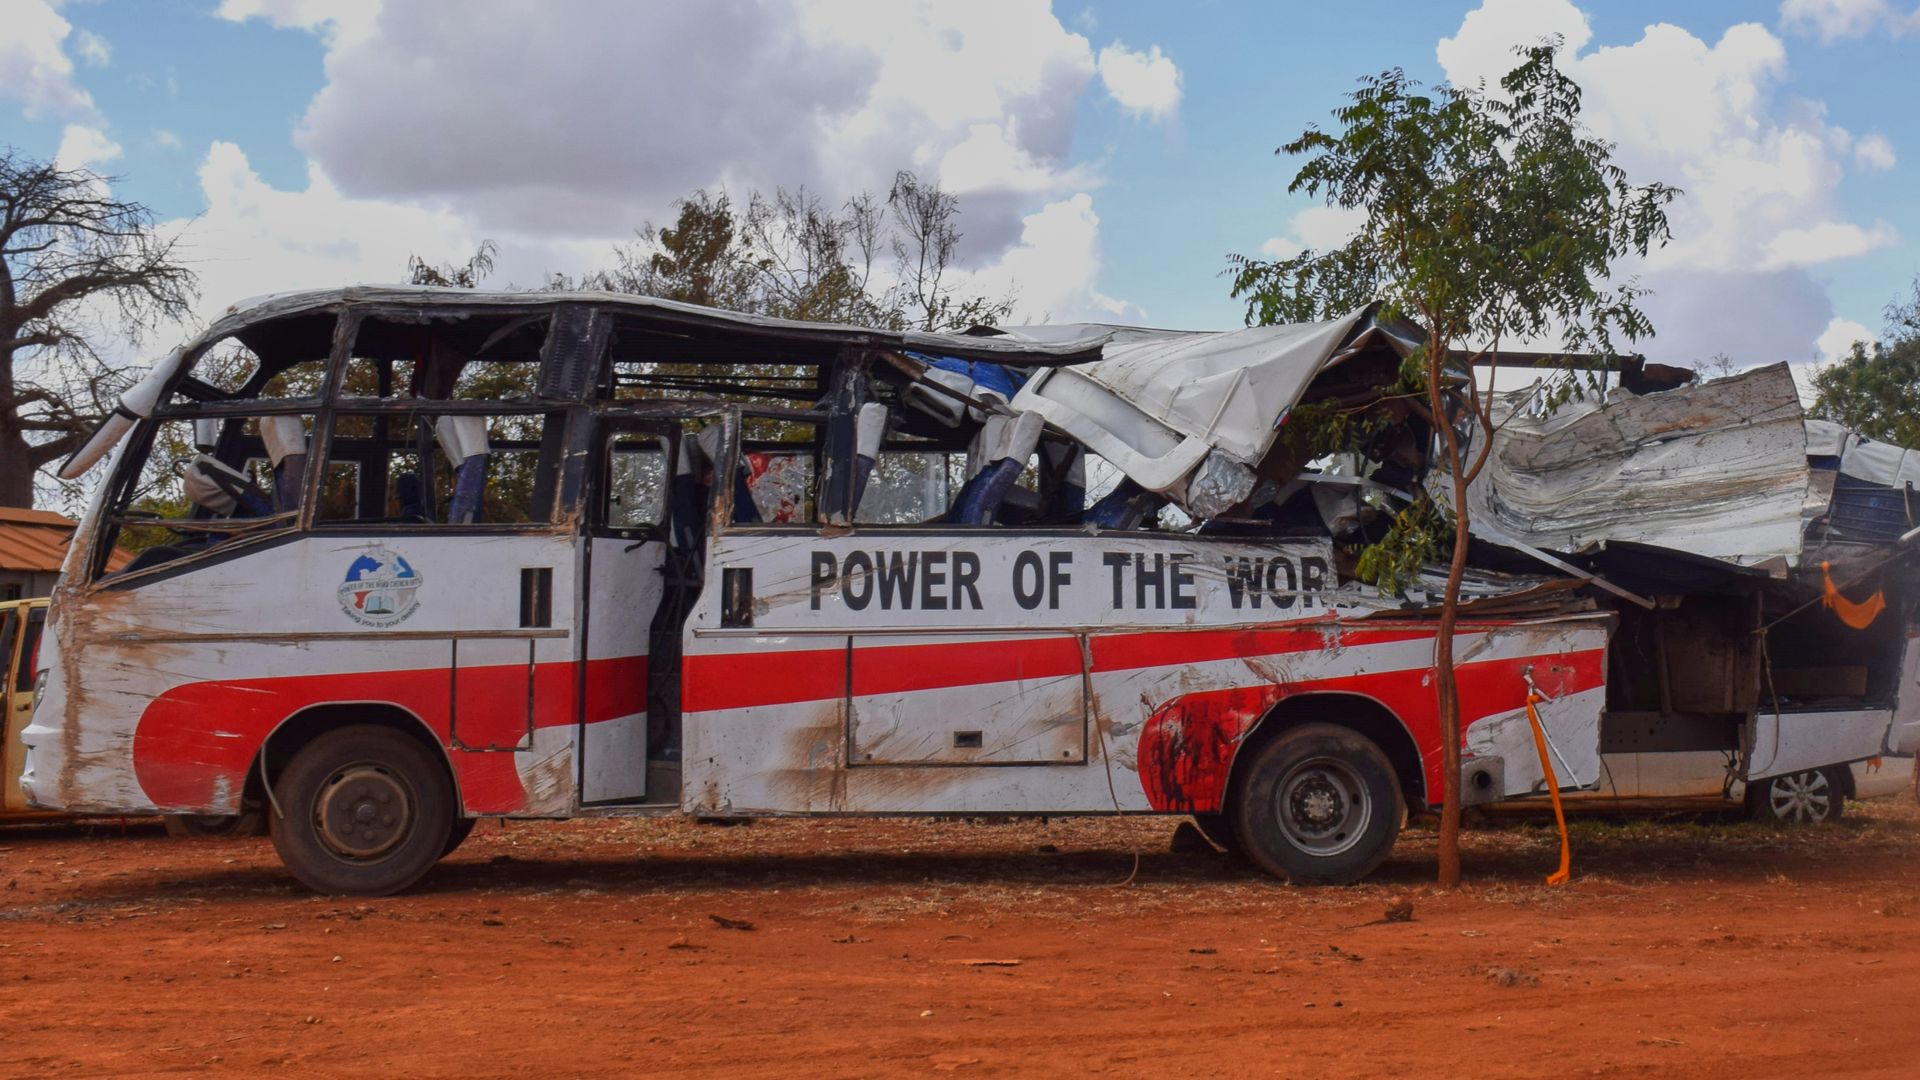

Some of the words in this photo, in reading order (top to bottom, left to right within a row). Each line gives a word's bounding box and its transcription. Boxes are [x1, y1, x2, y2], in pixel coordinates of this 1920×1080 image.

[810, 550, 983, 611] POWER
[1012, 550, 1073, 610] OF
[1103, 552, 1197, 609] THE
[1224, 556, 1359, 610] WOR
[360, 619, 375, 627] you
[384, 617, 400, 628] your
